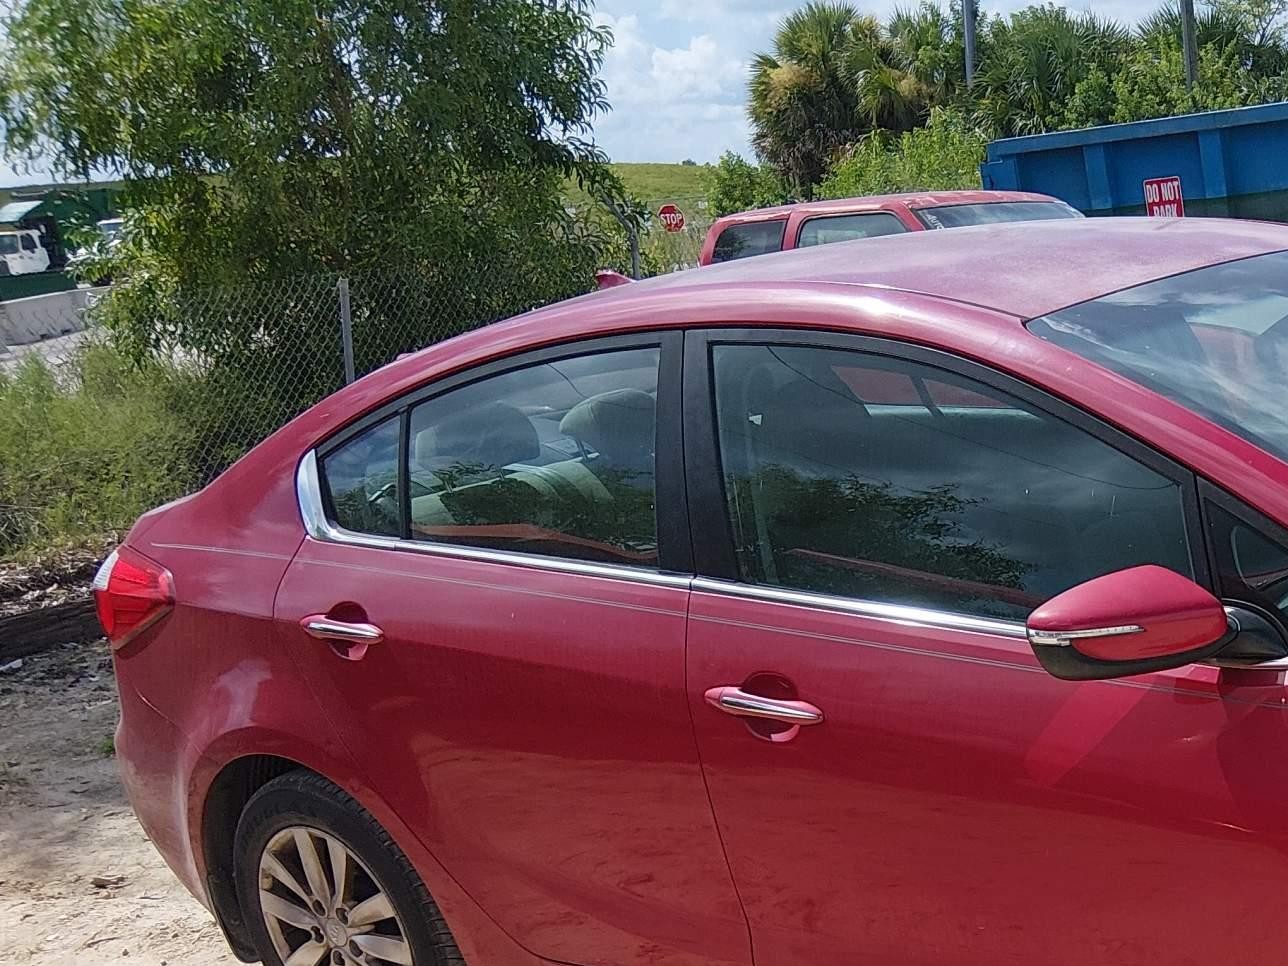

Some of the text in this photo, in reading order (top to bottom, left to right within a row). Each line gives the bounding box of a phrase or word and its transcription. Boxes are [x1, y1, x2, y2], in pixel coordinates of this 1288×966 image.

[1146, 181, 1180, 203] DO NOT
[660, 213, 683, 226] STOP
